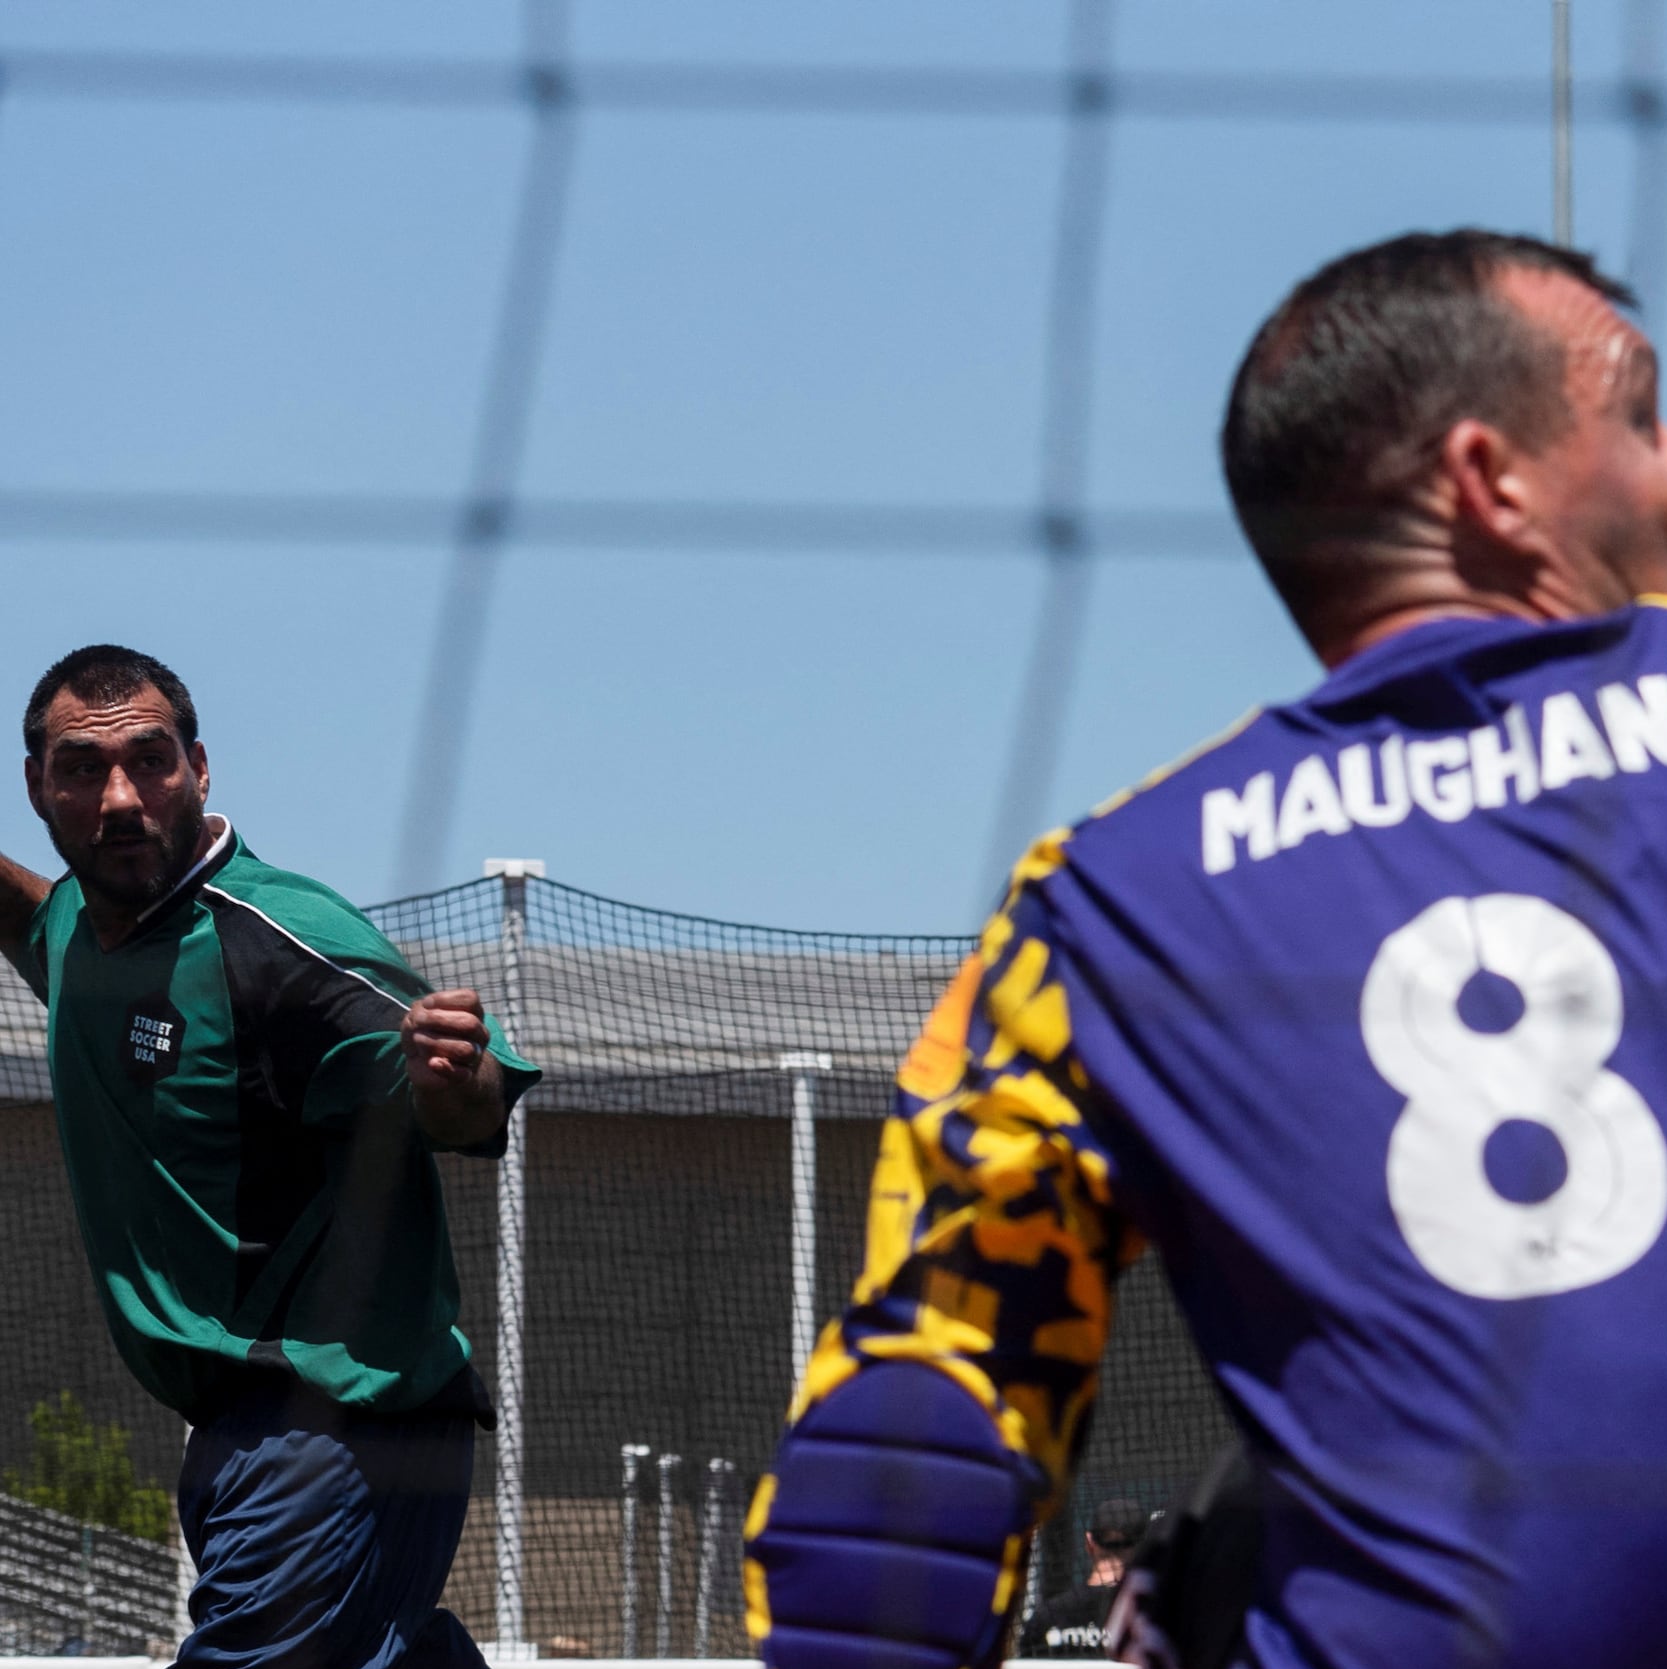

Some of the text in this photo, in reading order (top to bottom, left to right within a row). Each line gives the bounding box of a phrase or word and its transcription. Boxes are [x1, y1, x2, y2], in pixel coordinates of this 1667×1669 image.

[133, 1015, 173, 1036] STREET
[130, 1030, 171, 1052] SOCCER
[135, 1047, 156, 1064] USA
